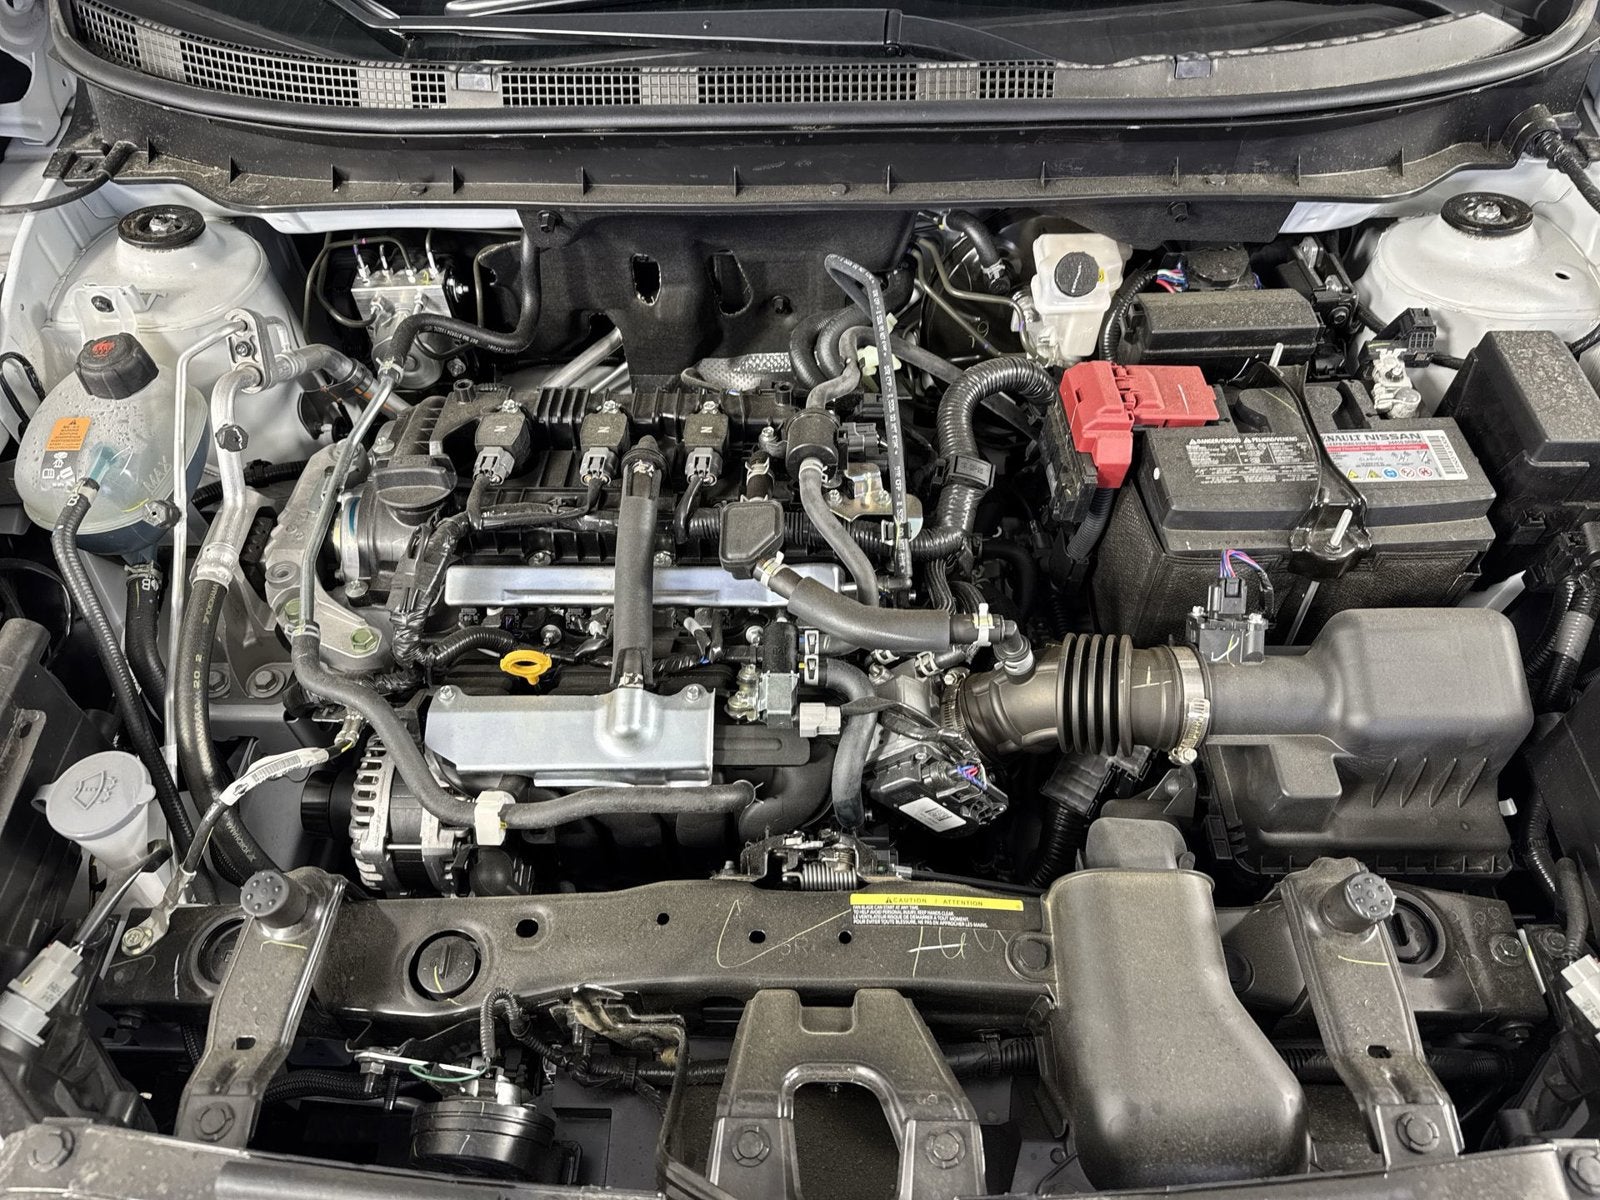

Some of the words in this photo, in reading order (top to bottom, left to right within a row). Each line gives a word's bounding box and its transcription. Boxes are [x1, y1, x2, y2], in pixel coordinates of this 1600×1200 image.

[1322, 434, 1361, 442] NAULT
[1365, 432, 1421, 441] NISSAN
[142, 455, 172, 492] MAX
